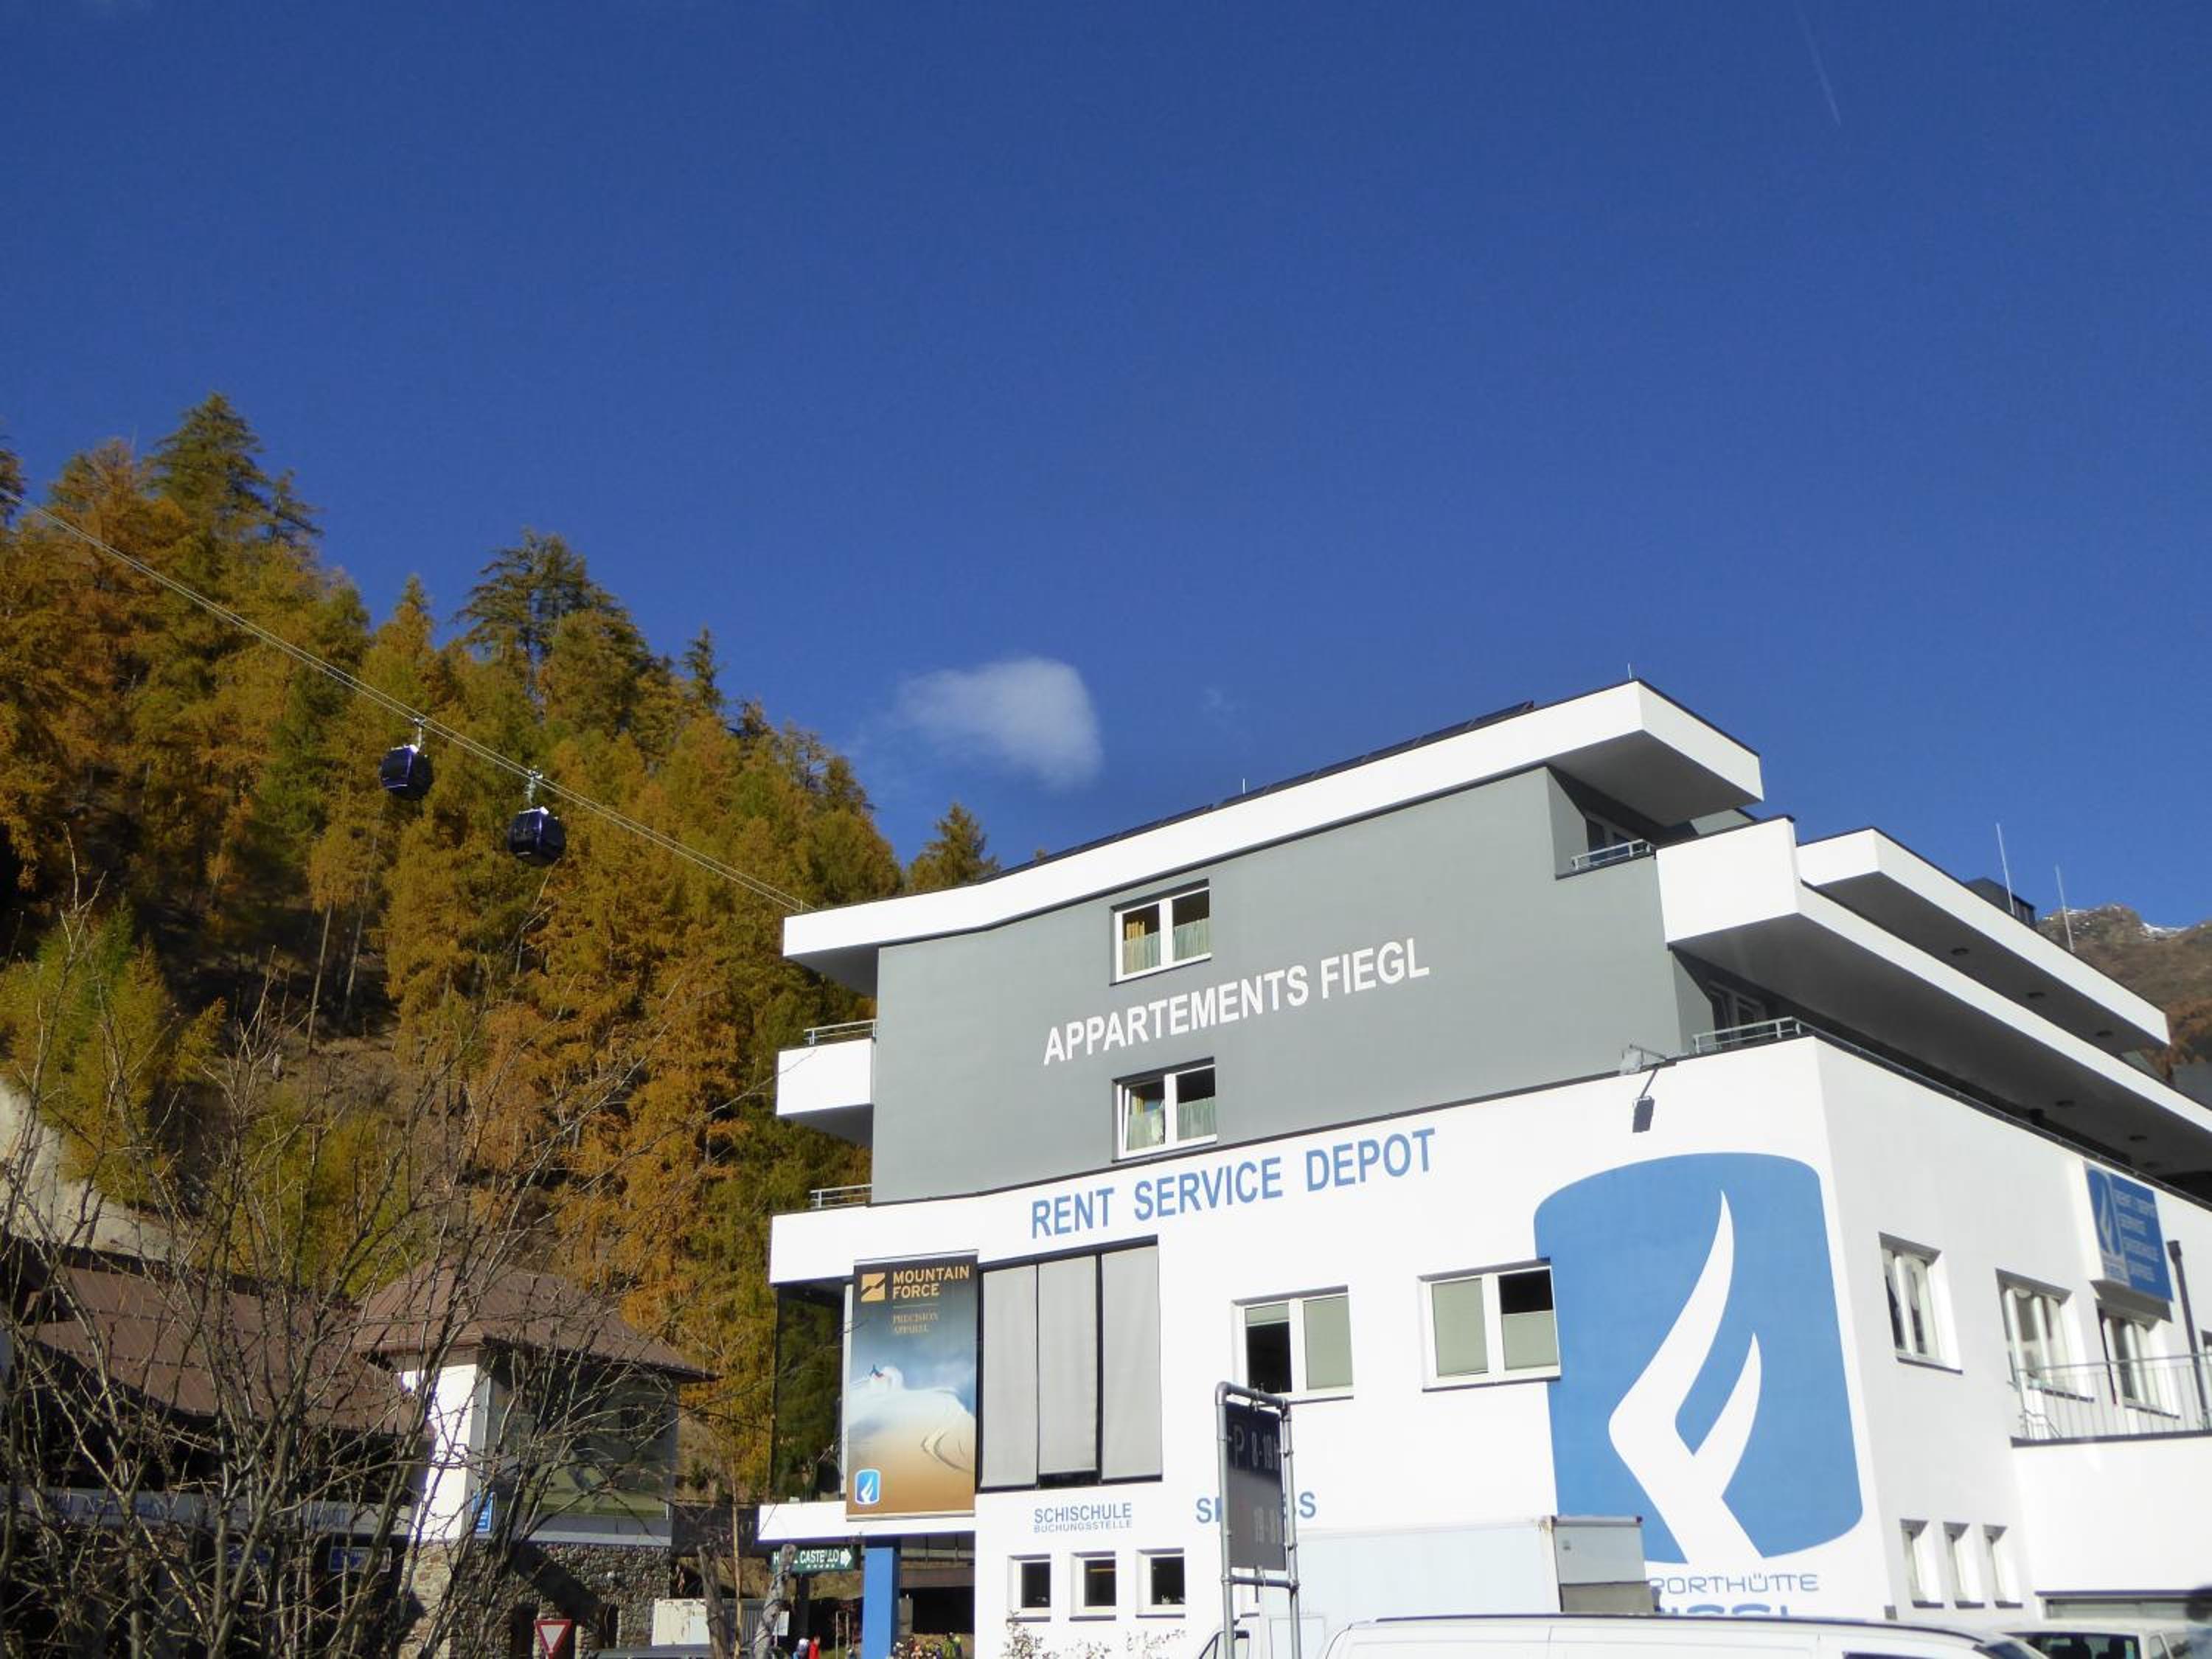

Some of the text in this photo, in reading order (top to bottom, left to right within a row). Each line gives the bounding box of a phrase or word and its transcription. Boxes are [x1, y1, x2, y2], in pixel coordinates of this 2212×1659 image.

[1043, 937, 1430, 1066] APPARTEMENTS FIEGL
[1032, 1127, 1436, 1239] RENT SERVICE DEPOT
[892, 1265, 970, 1285] MOUNTAIN
[892, 1283, 940, 1301] FORCE
[1034, 1502, 1133, 1524] SCHISCHULE
[1033, 1519, 1133, 1534] BUCHUNGSSTELLE
[799, 1549, 840, 1564] CASTELLO
[1648, 1573, 1820, 1595] PORTHÜTTE
